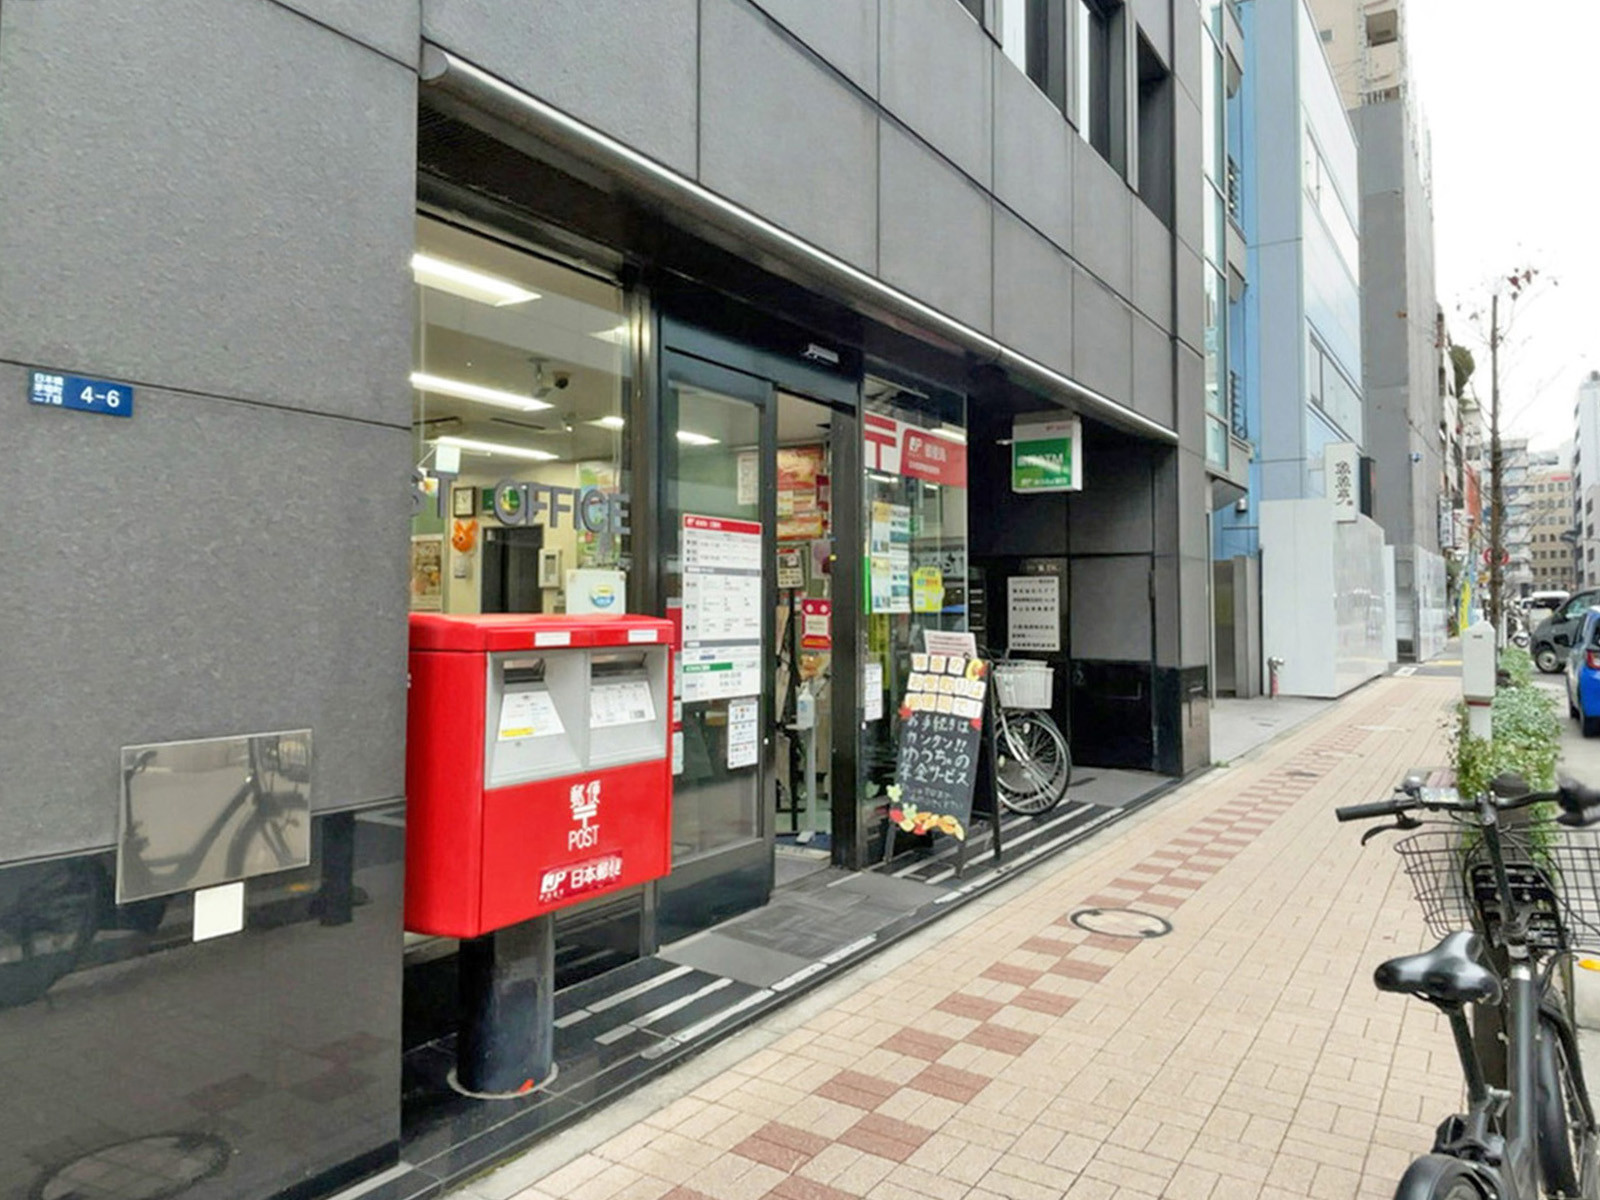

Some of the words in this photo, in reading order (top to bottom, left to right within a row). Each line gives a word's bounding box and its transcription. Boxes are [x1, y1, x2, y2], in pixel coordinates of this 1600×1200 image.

[80, 385, 121, 408] 4-6
[493, 478, 631, 536] OFFICE
[570, 780, 600, 808] 郵便
[568, 825, 599, 851] POST
